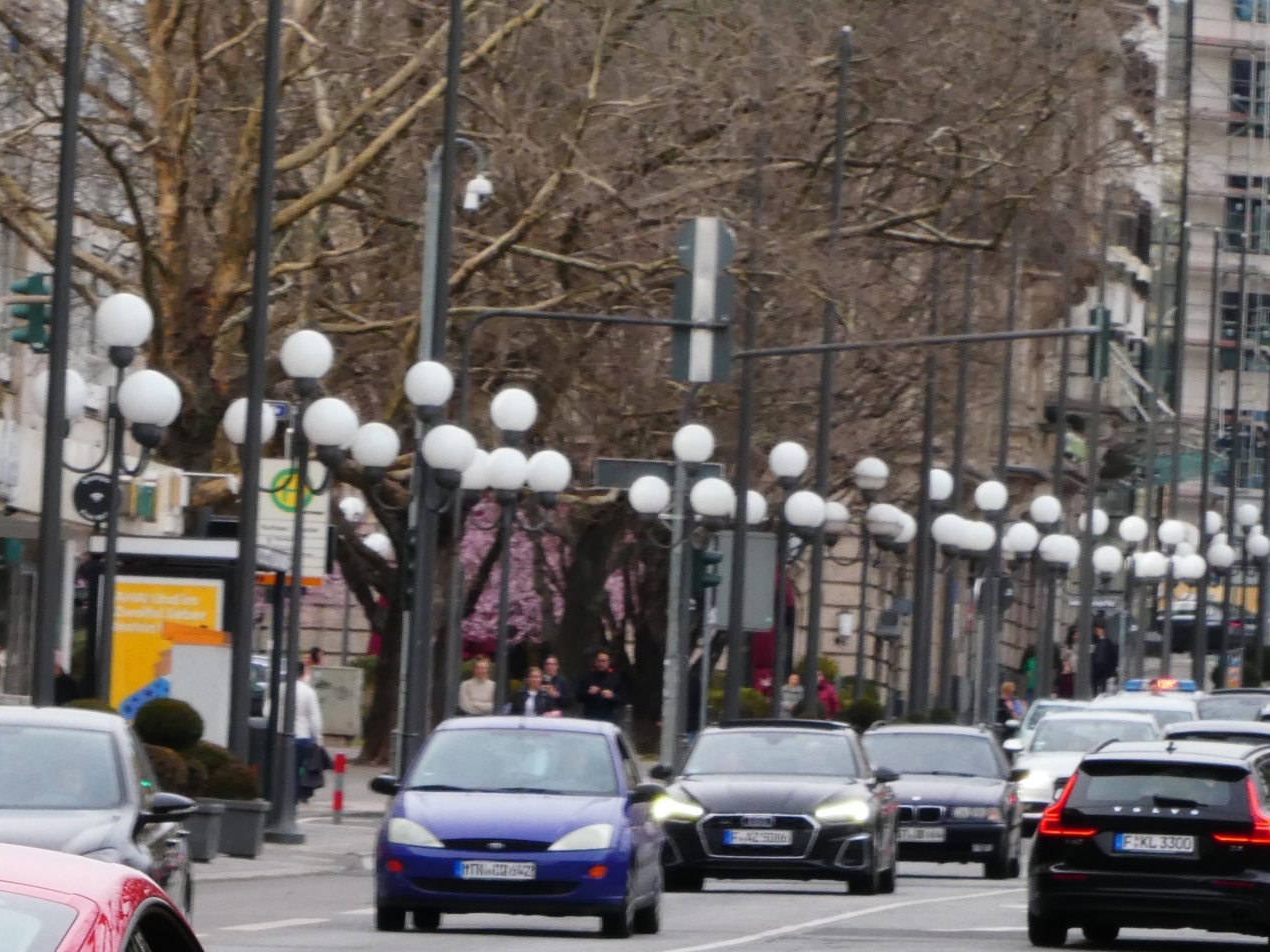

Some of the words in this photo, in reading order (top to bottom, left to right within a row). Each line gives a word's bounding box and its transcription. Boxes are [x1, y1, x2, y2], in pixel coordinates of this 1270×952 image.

[1113, 806, 1199, 816] VOLVO
[1124, 836, 1131, 848] F
[1139, 836, 1156, 849] KL
[1159, 838, 1191, 851] 3300
